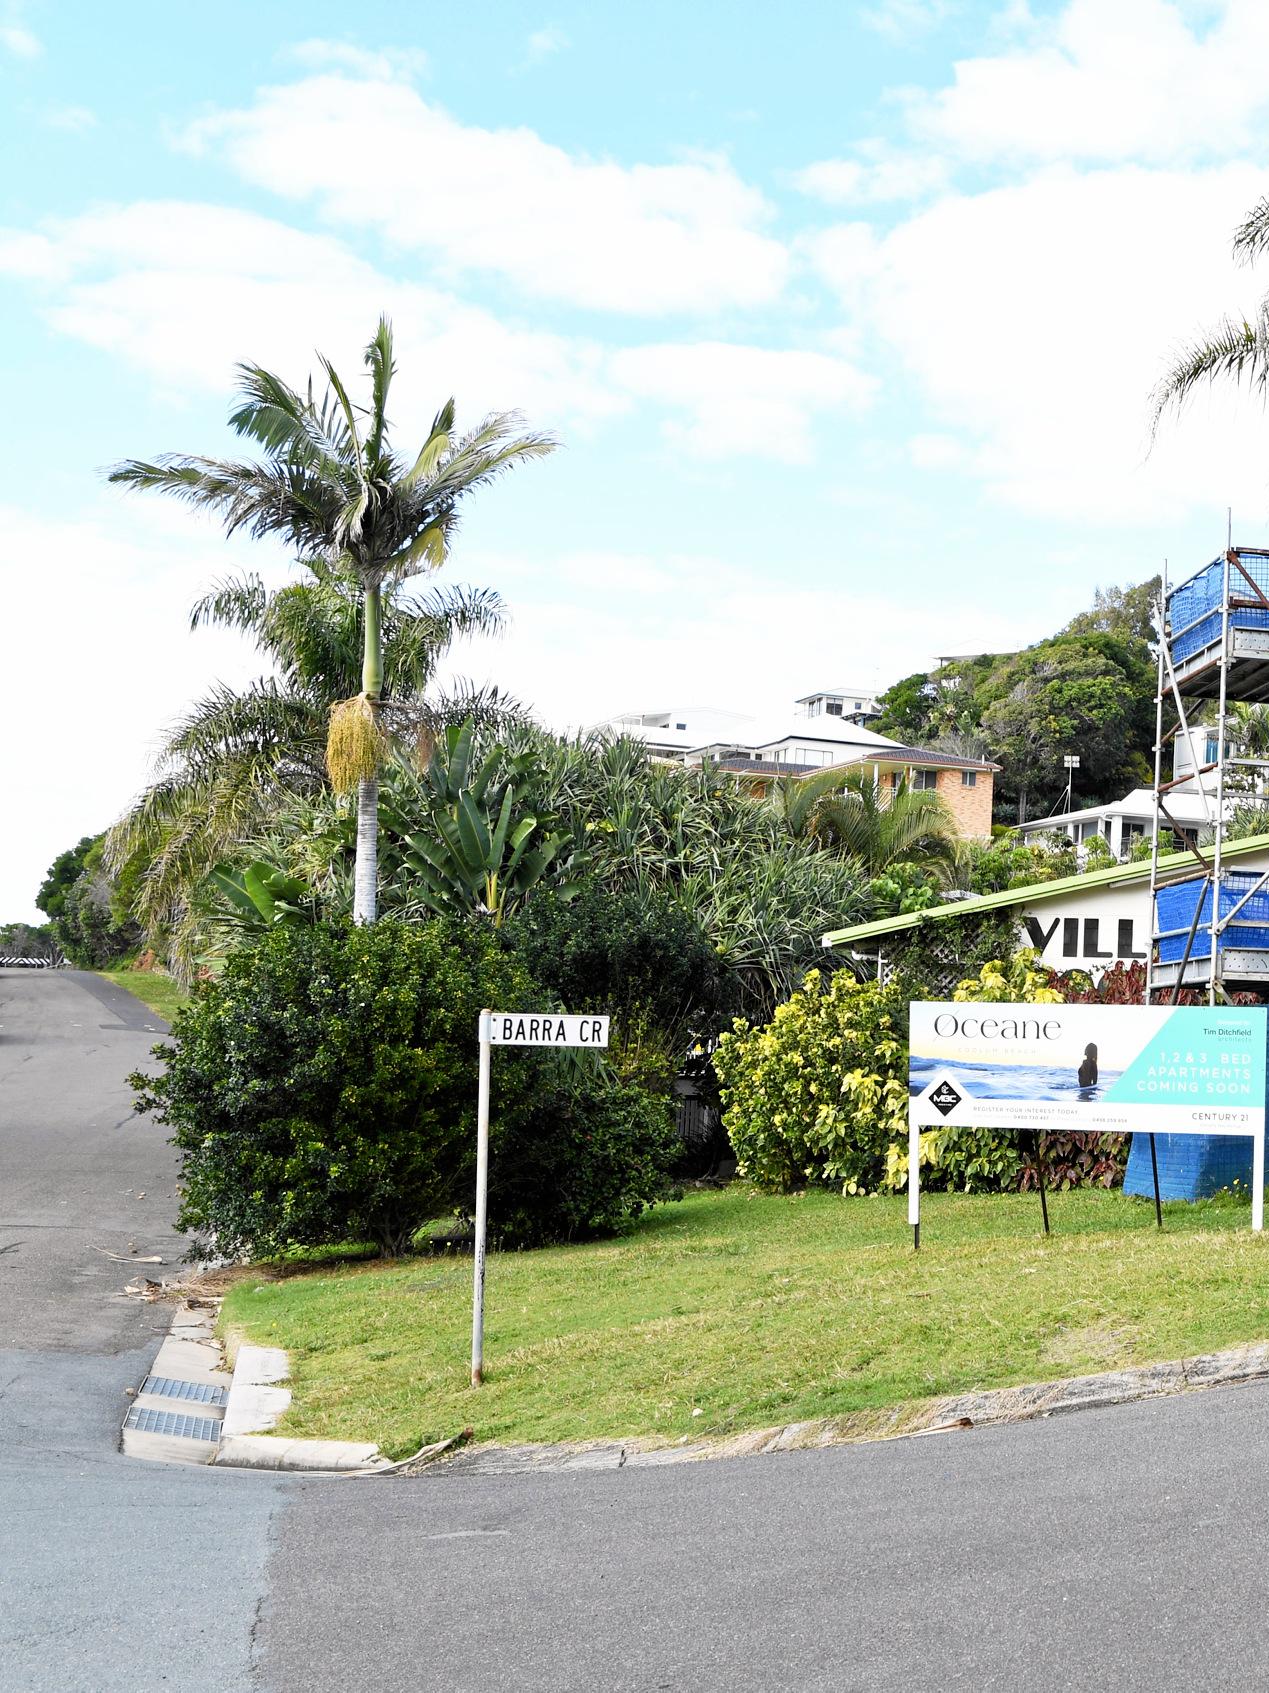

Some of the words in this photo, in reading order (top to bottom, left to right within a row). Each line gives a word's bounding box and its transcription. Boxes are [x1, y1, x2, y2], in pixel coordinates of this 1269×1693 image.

[503, 1018, 567, 1042] BARRA
[579, 1019, 602, 1043] CR
[1203, 1028, 1217, 1036] Tim
[1218, 1028, 1252, 1037] Ditchfield
[1200, 1053, 1207, 1064] 3
[1220, 1053, 1251, 1065] BED
[1147, 1065, 1251, 1080] APARTMENTS
[1136, 1080, 1198, 1093] COMING
[1206, 1082, 1250, 1095] SOON
[1024, 1107, 1055, 1115] INTEREST
[1191, 1112, 1238, 1121] CENTURY
[1240, 1113, 1249, 1122] 21
